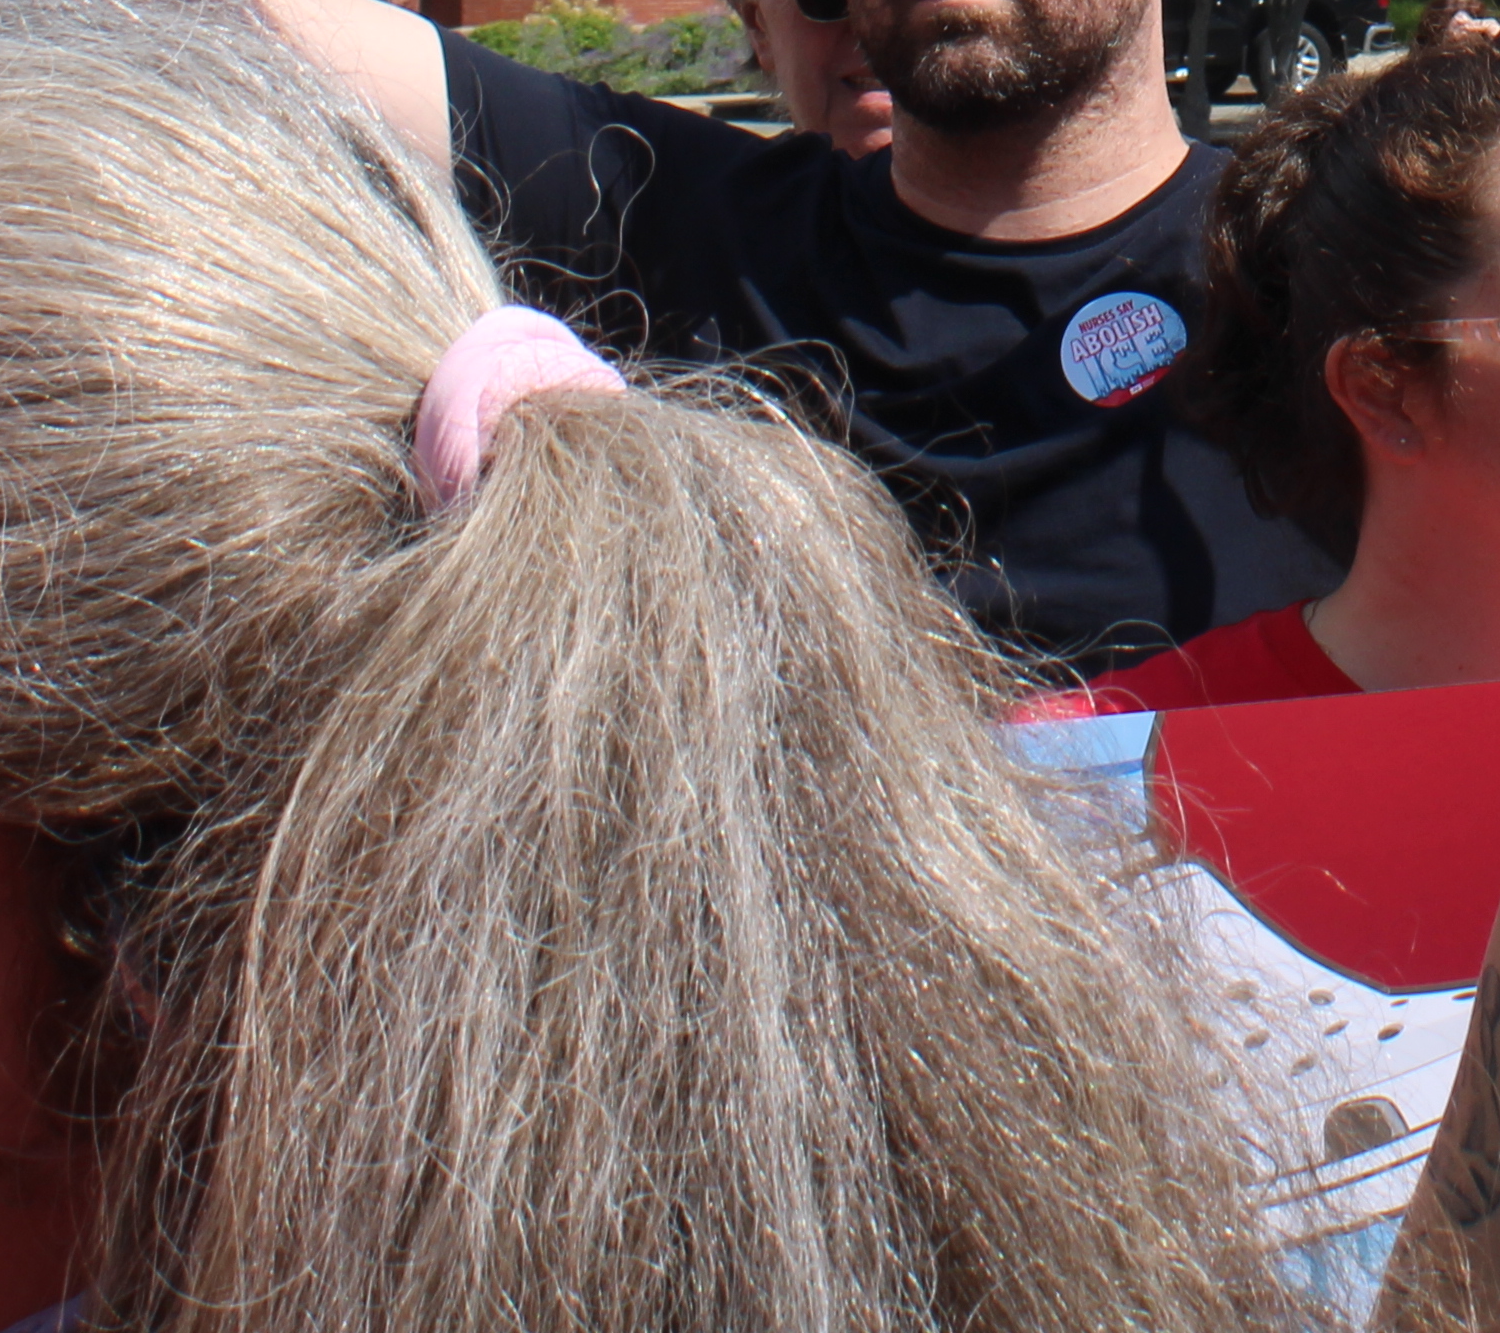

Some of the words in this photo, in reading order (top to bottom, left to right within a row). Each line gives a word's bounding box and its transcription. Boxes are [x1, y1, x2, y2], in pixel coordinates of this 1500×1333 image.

[1070, 301, 1164, 364] ABOLISH
[1078, 308, 1116, 334] NURSES
[1116, 298, 1135, 315] SAY
